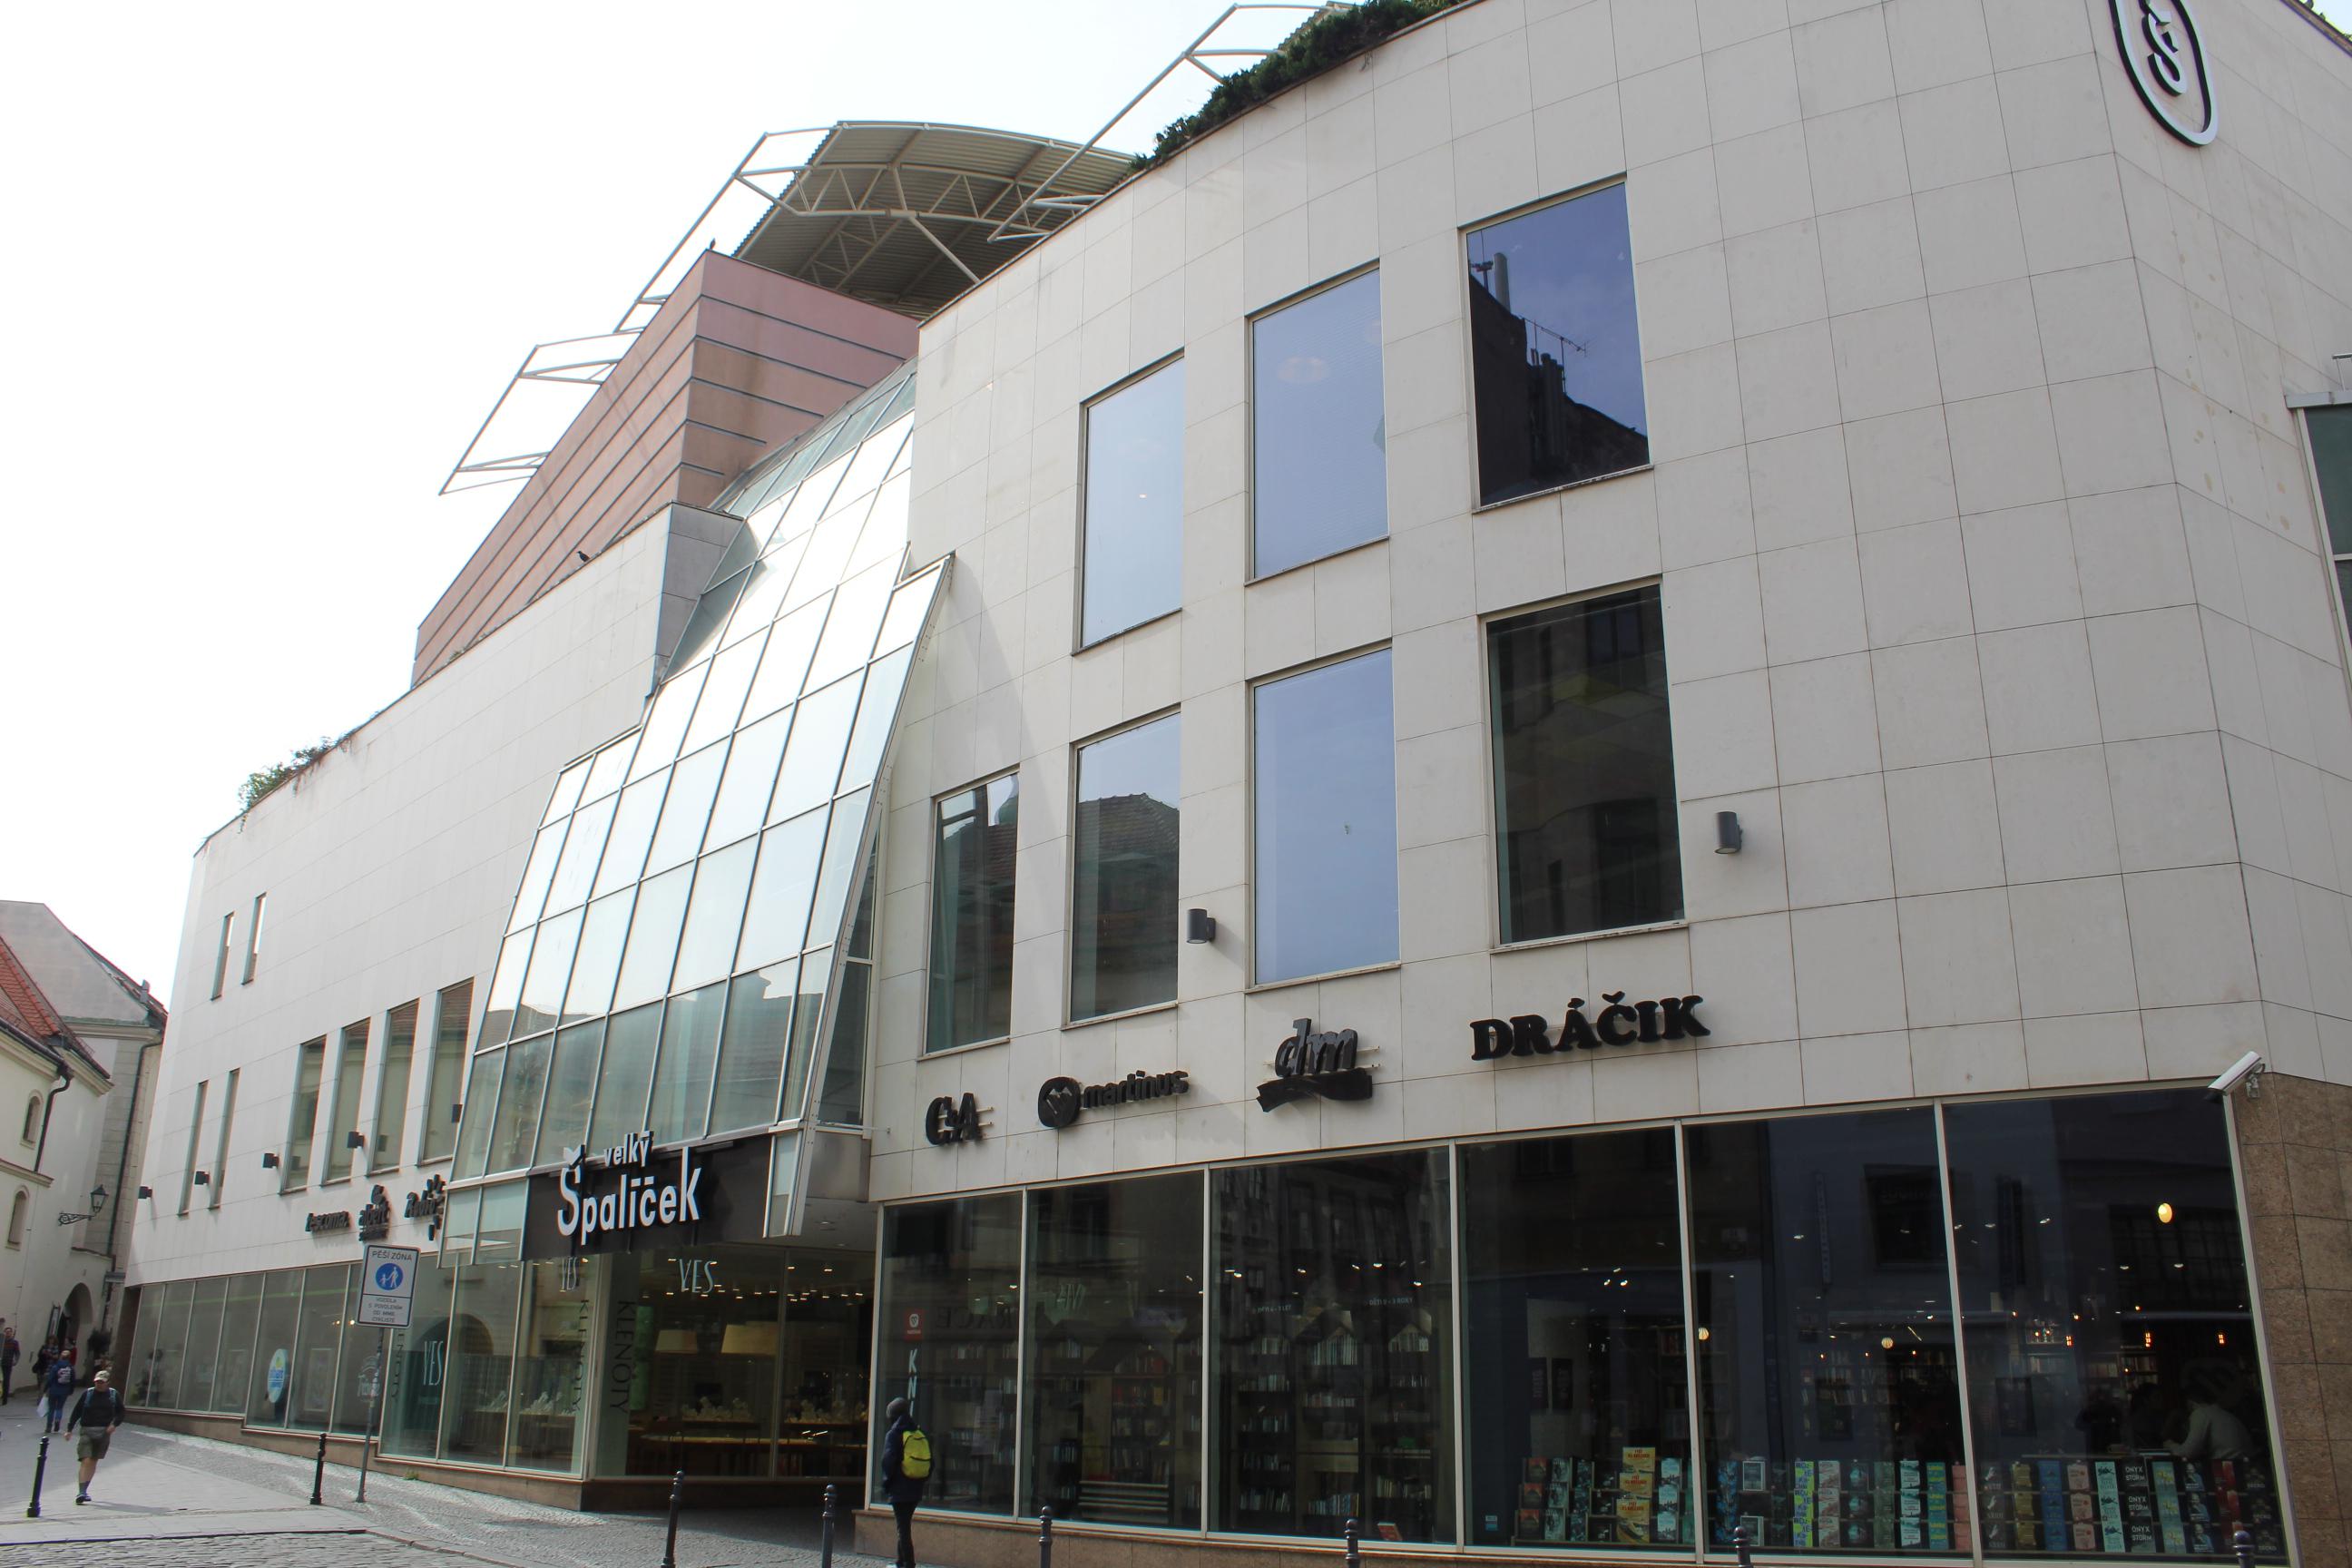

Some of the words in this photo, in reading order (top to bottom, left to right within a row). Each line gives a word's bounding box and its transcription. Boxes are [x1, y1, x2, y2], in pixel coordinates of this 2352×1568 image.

[1272, 1017, 1358, 1078] dm
[1469, 990, 1711, 1062] DRÁČIK
[1083, 1065, 1191, 1110] martinus
[924, 1092, 985, 1147] C&A
[603, 1130, 654, 1170] velký
[358, 1200, 390, 1227] albert
[556, 1143, 703, 1247] Špalíček
[391, 1251, 412, 1262] ZÓNA
[678, 1258, 714, 1293] YES
[421, 1340, 445, 1387] YES
[609, 1300, 637, 1414] KLENOTY
[907, 1348, 918, 1417] KNI
